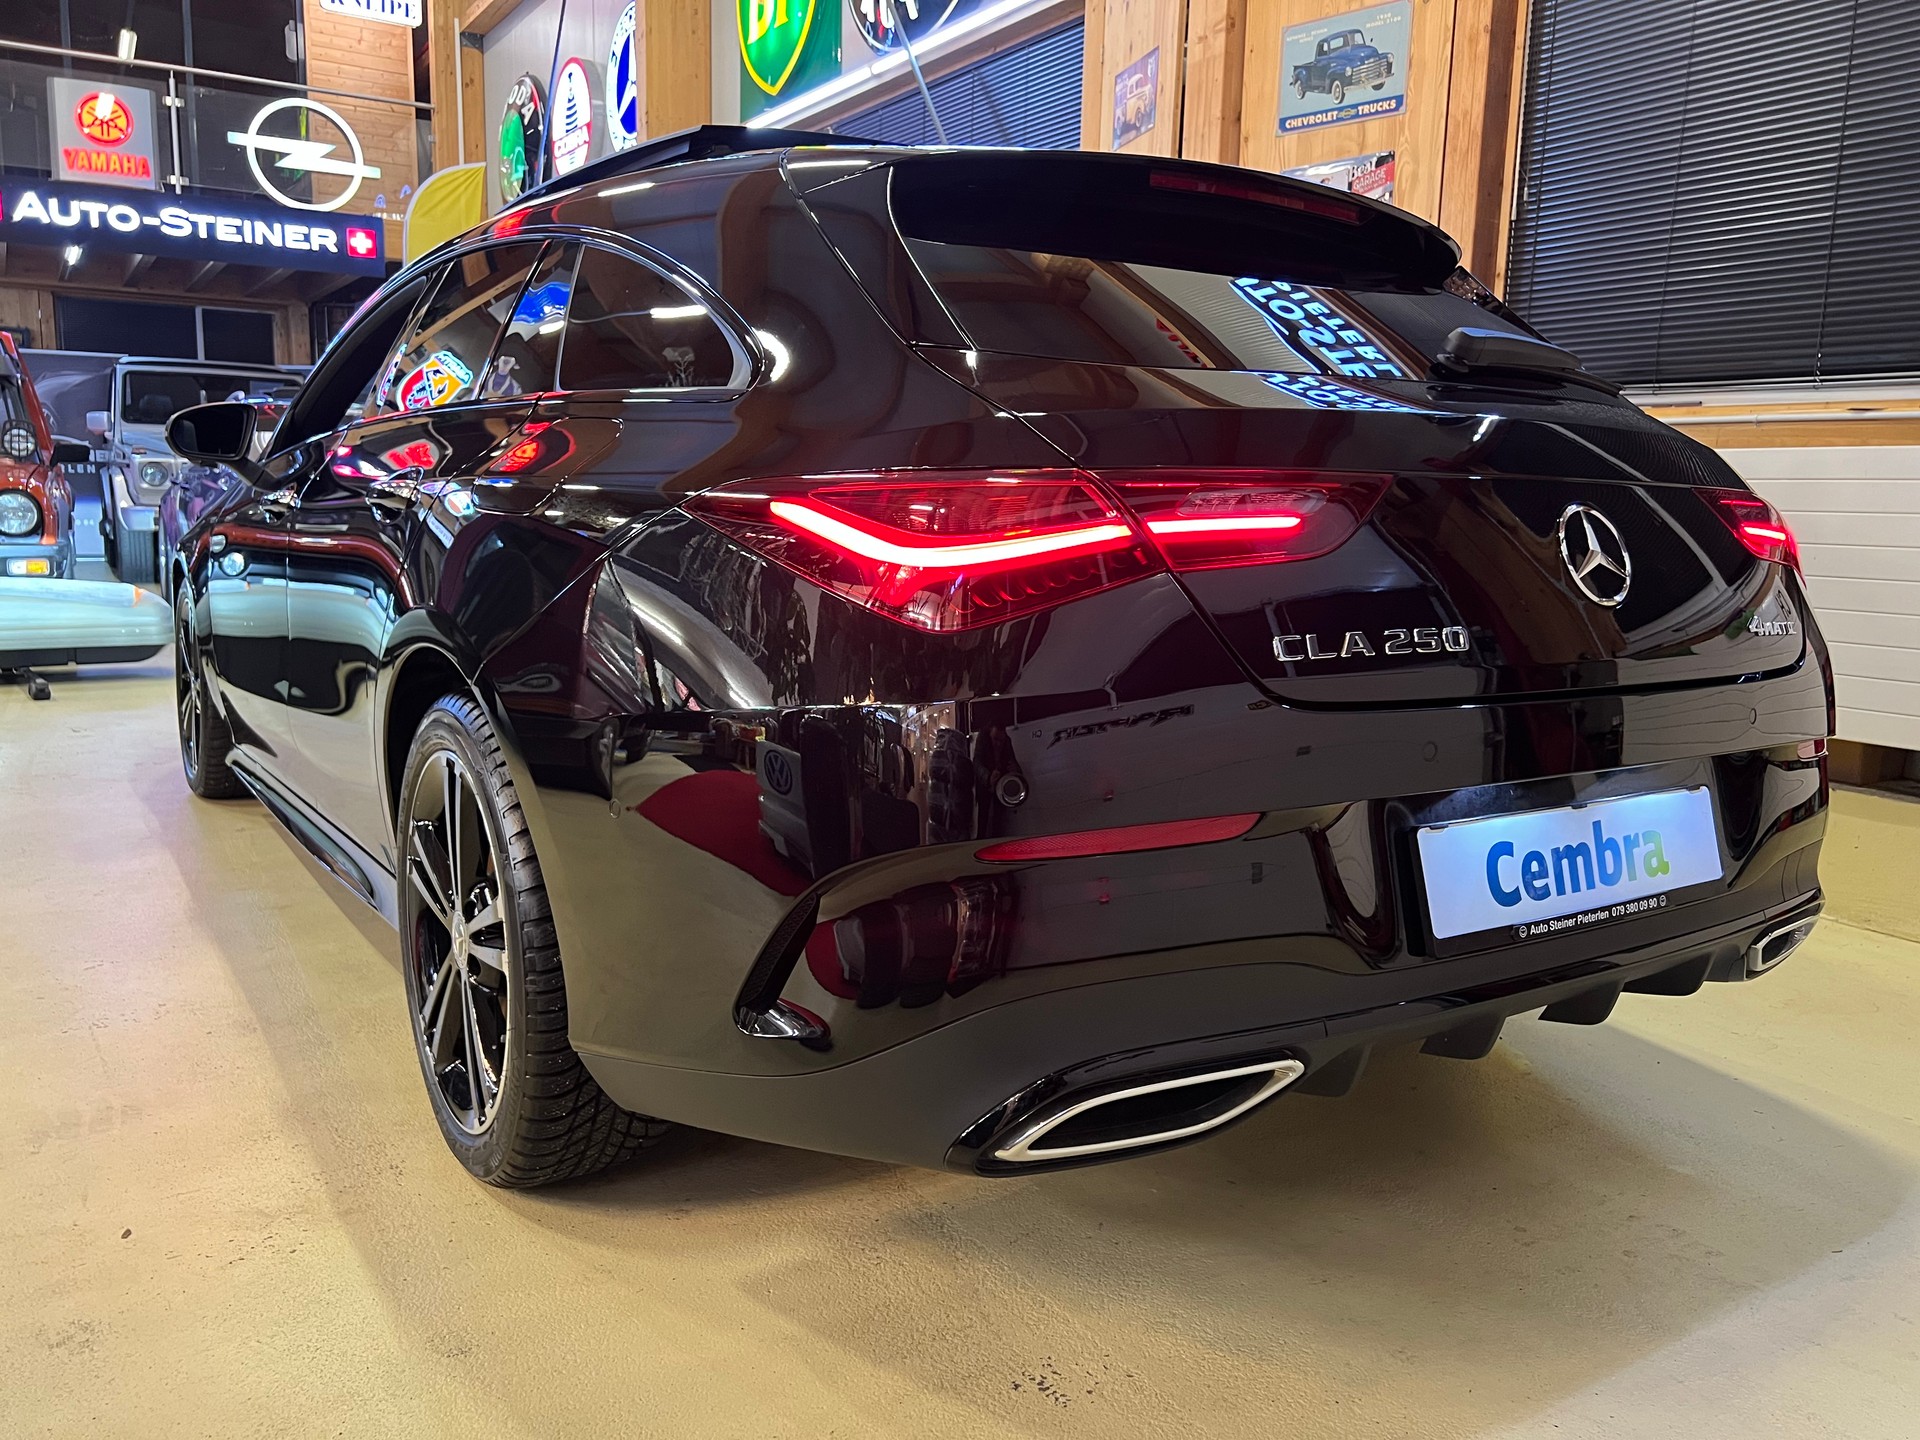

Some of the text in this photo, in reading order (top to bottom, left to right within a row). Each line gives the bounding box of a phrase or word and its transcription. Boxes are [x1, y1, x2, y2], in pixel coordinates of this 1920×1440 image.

[1285, 99, 1397, 129] CHEVROLET TRUCKS
[63, 148, 151, 179] YAMAHA
[1353, 168, 1387, 190] GARAGE
[12, 190, 340, 253] AUTO-STEINER
[1272, 625, 1471, 662] CLA 250
[1486, 819, 1671, 908] Cembra
[1529, 897, 1658, 936] Auto Steiner Pieterlen 079 380 09 90
